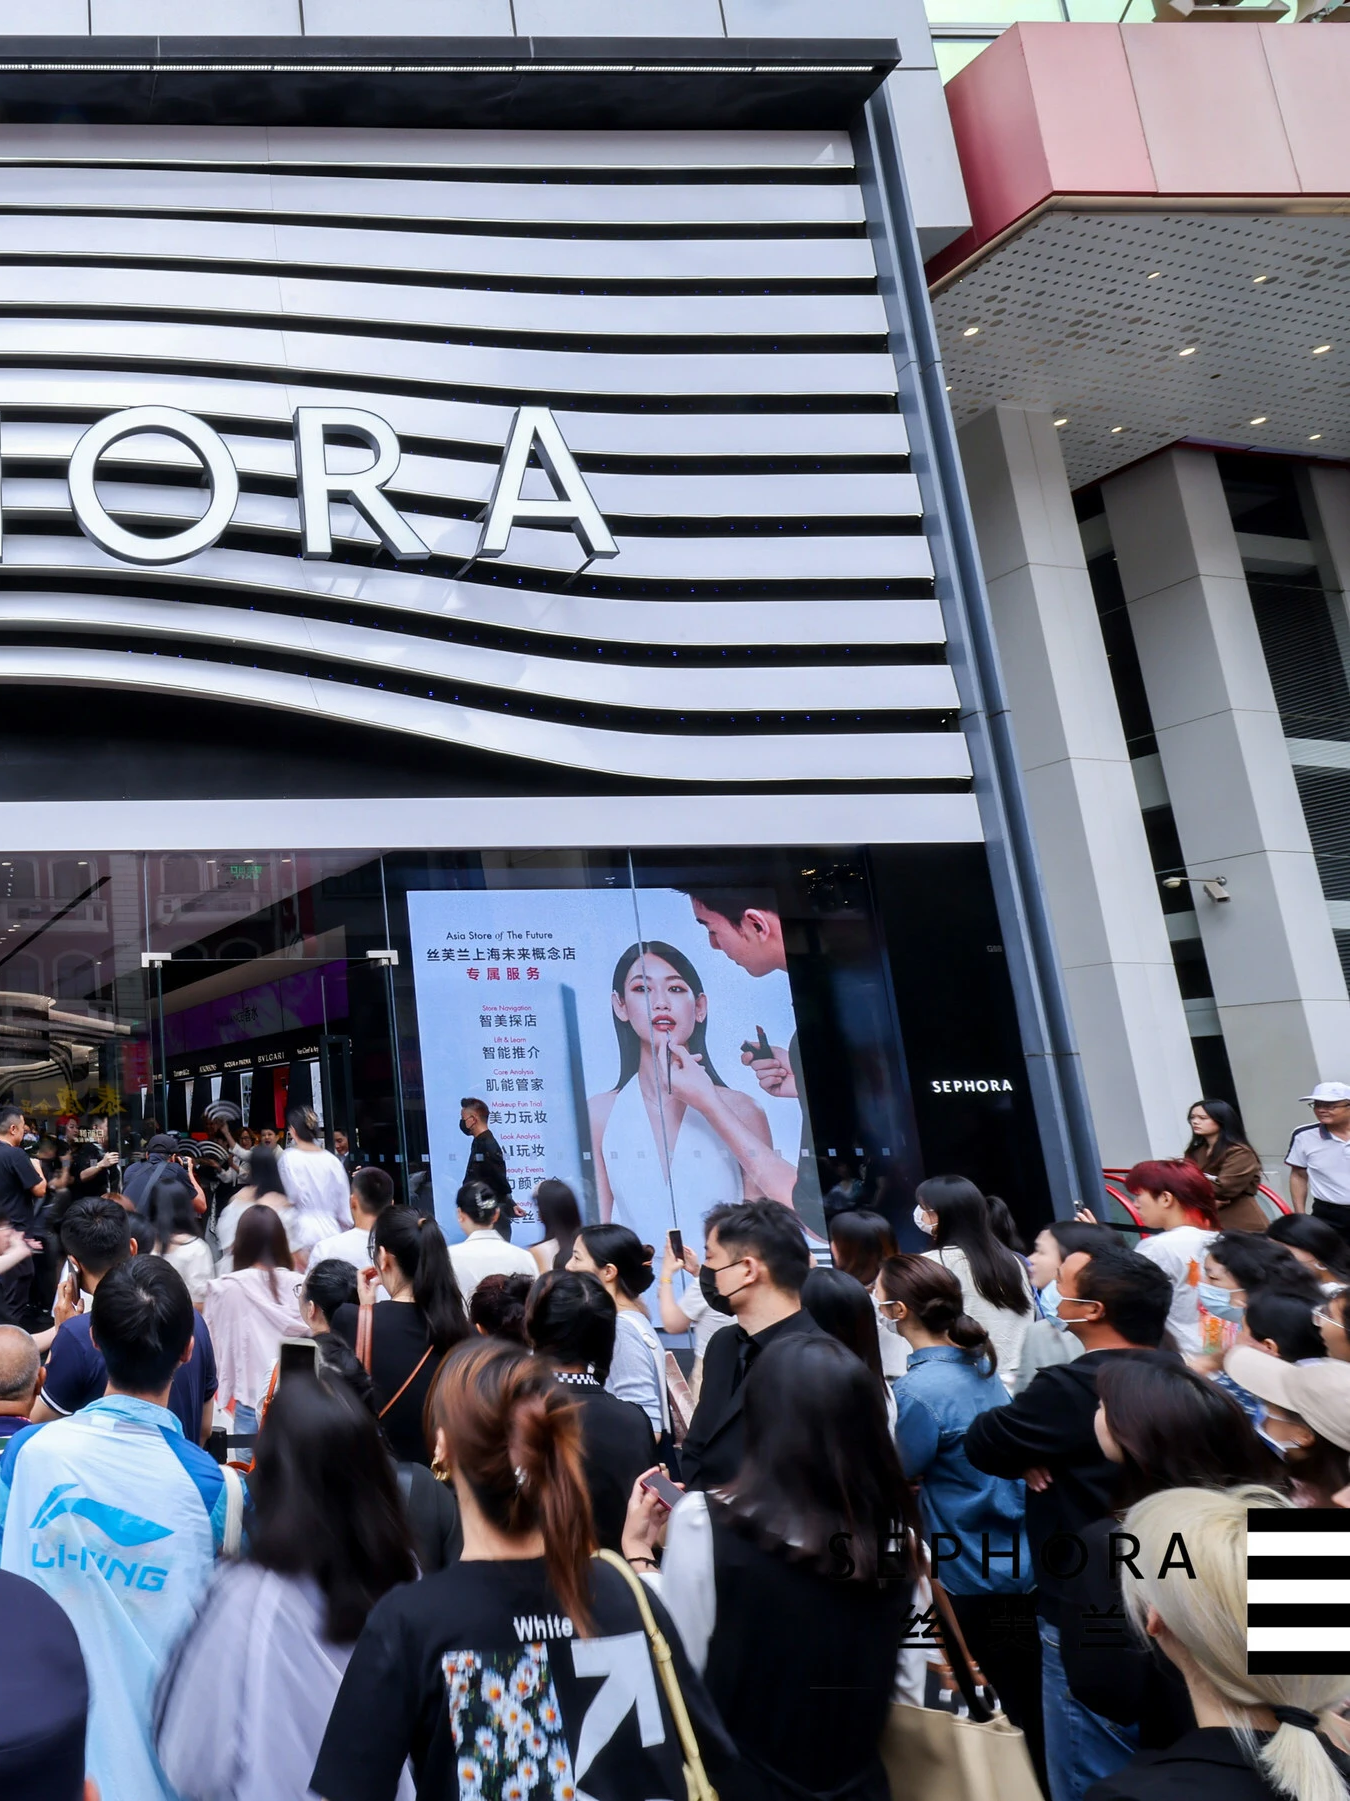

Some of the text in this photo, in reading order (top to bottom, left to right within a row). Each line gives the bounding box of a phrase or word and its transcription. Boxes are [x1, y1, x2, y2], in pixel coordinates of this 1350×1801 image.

[446, 930, 553, 941] Asia Store of The Future
[426, 947, 576, 962] 丝芙兰上海未来概念店
[466, 967, 540, 981] 专属服务
[479, 1014, 537, 1027] 智美探店
[257, 1052, 285, 1063] BVLGARI
[482, 1046, 540, 1060] 智能推介
[486, 1078, 544, 1092] 肌能管家
[932, 1079, 1013, 1093] SEPHORA
[489, 1110, 548, 1124] 美力玩妆
[513, 1613, 573, 1642] White
